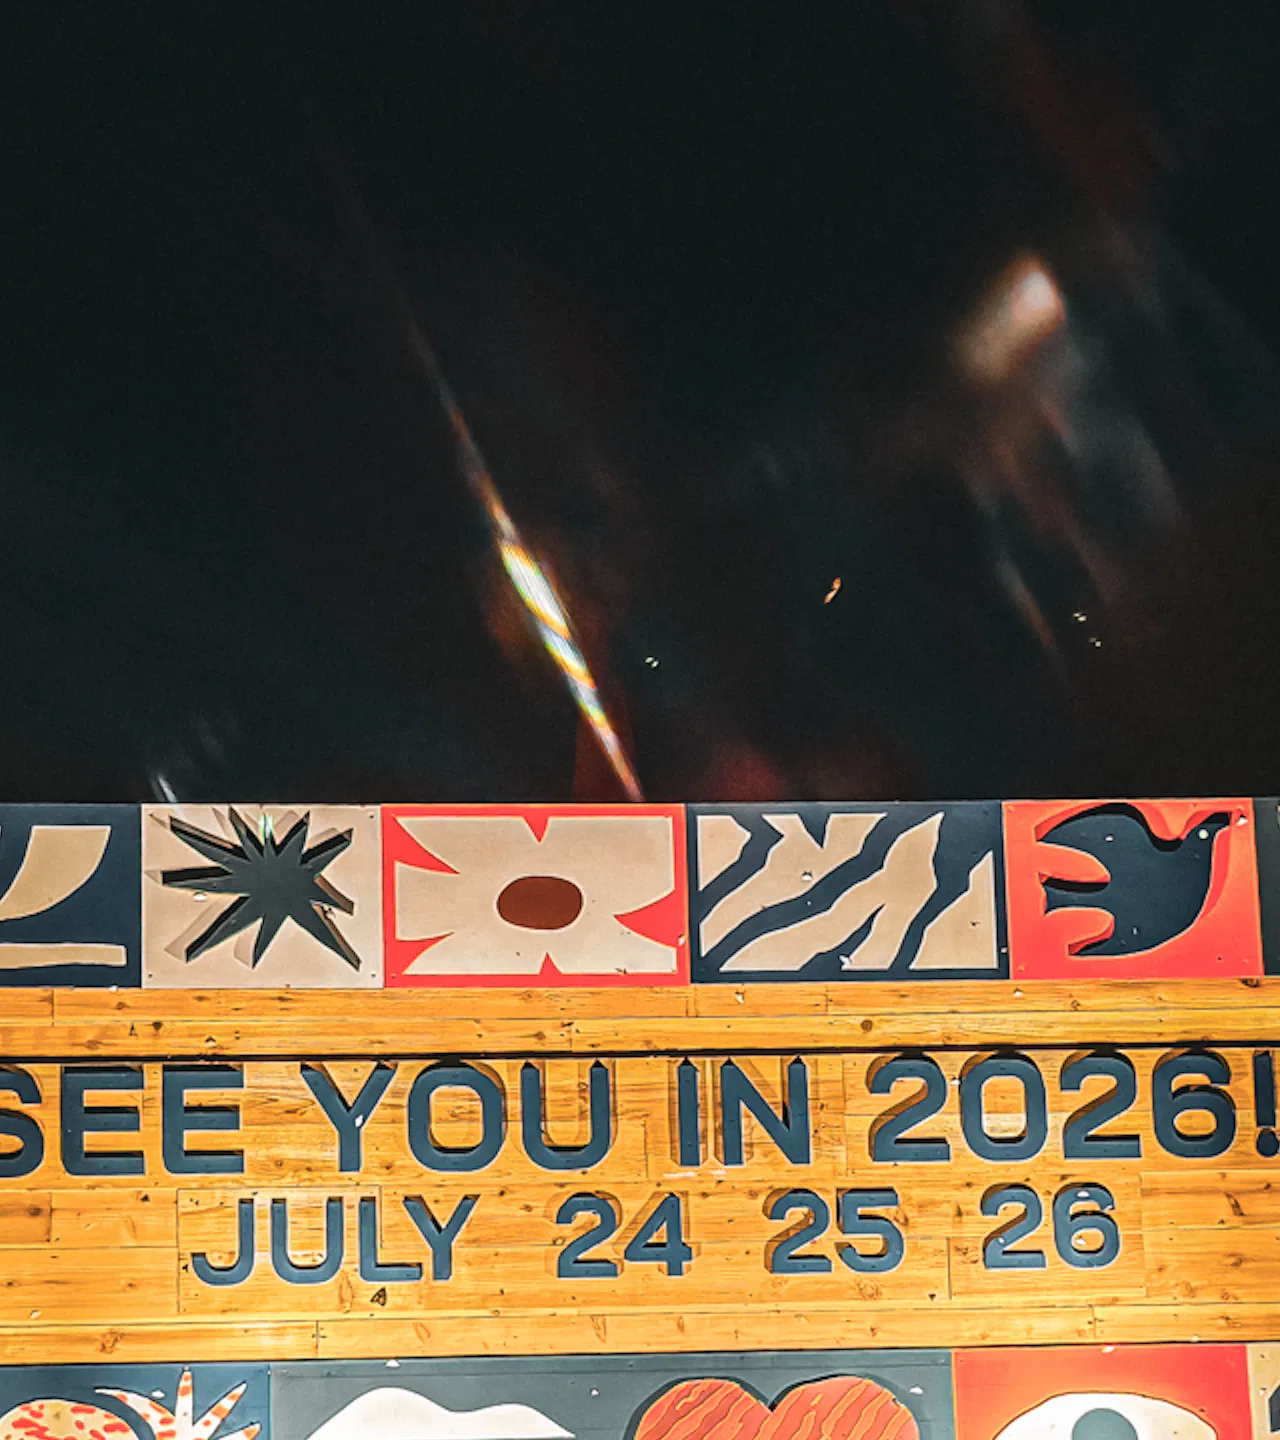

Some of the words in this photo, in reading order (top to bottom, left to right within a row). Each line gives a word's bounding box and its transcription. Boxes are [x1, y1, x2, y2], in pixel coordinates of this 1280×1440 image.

[300, 1060, 613, 1171] YOU
[677, 1056, 811, 1166] IN
[192, 1194, 480, 1285] JULY
[555, 1192, 693, 1279] 24
[765, 1187, 904, 1274] 25
[981, 1182, 1120, 1269] 26
